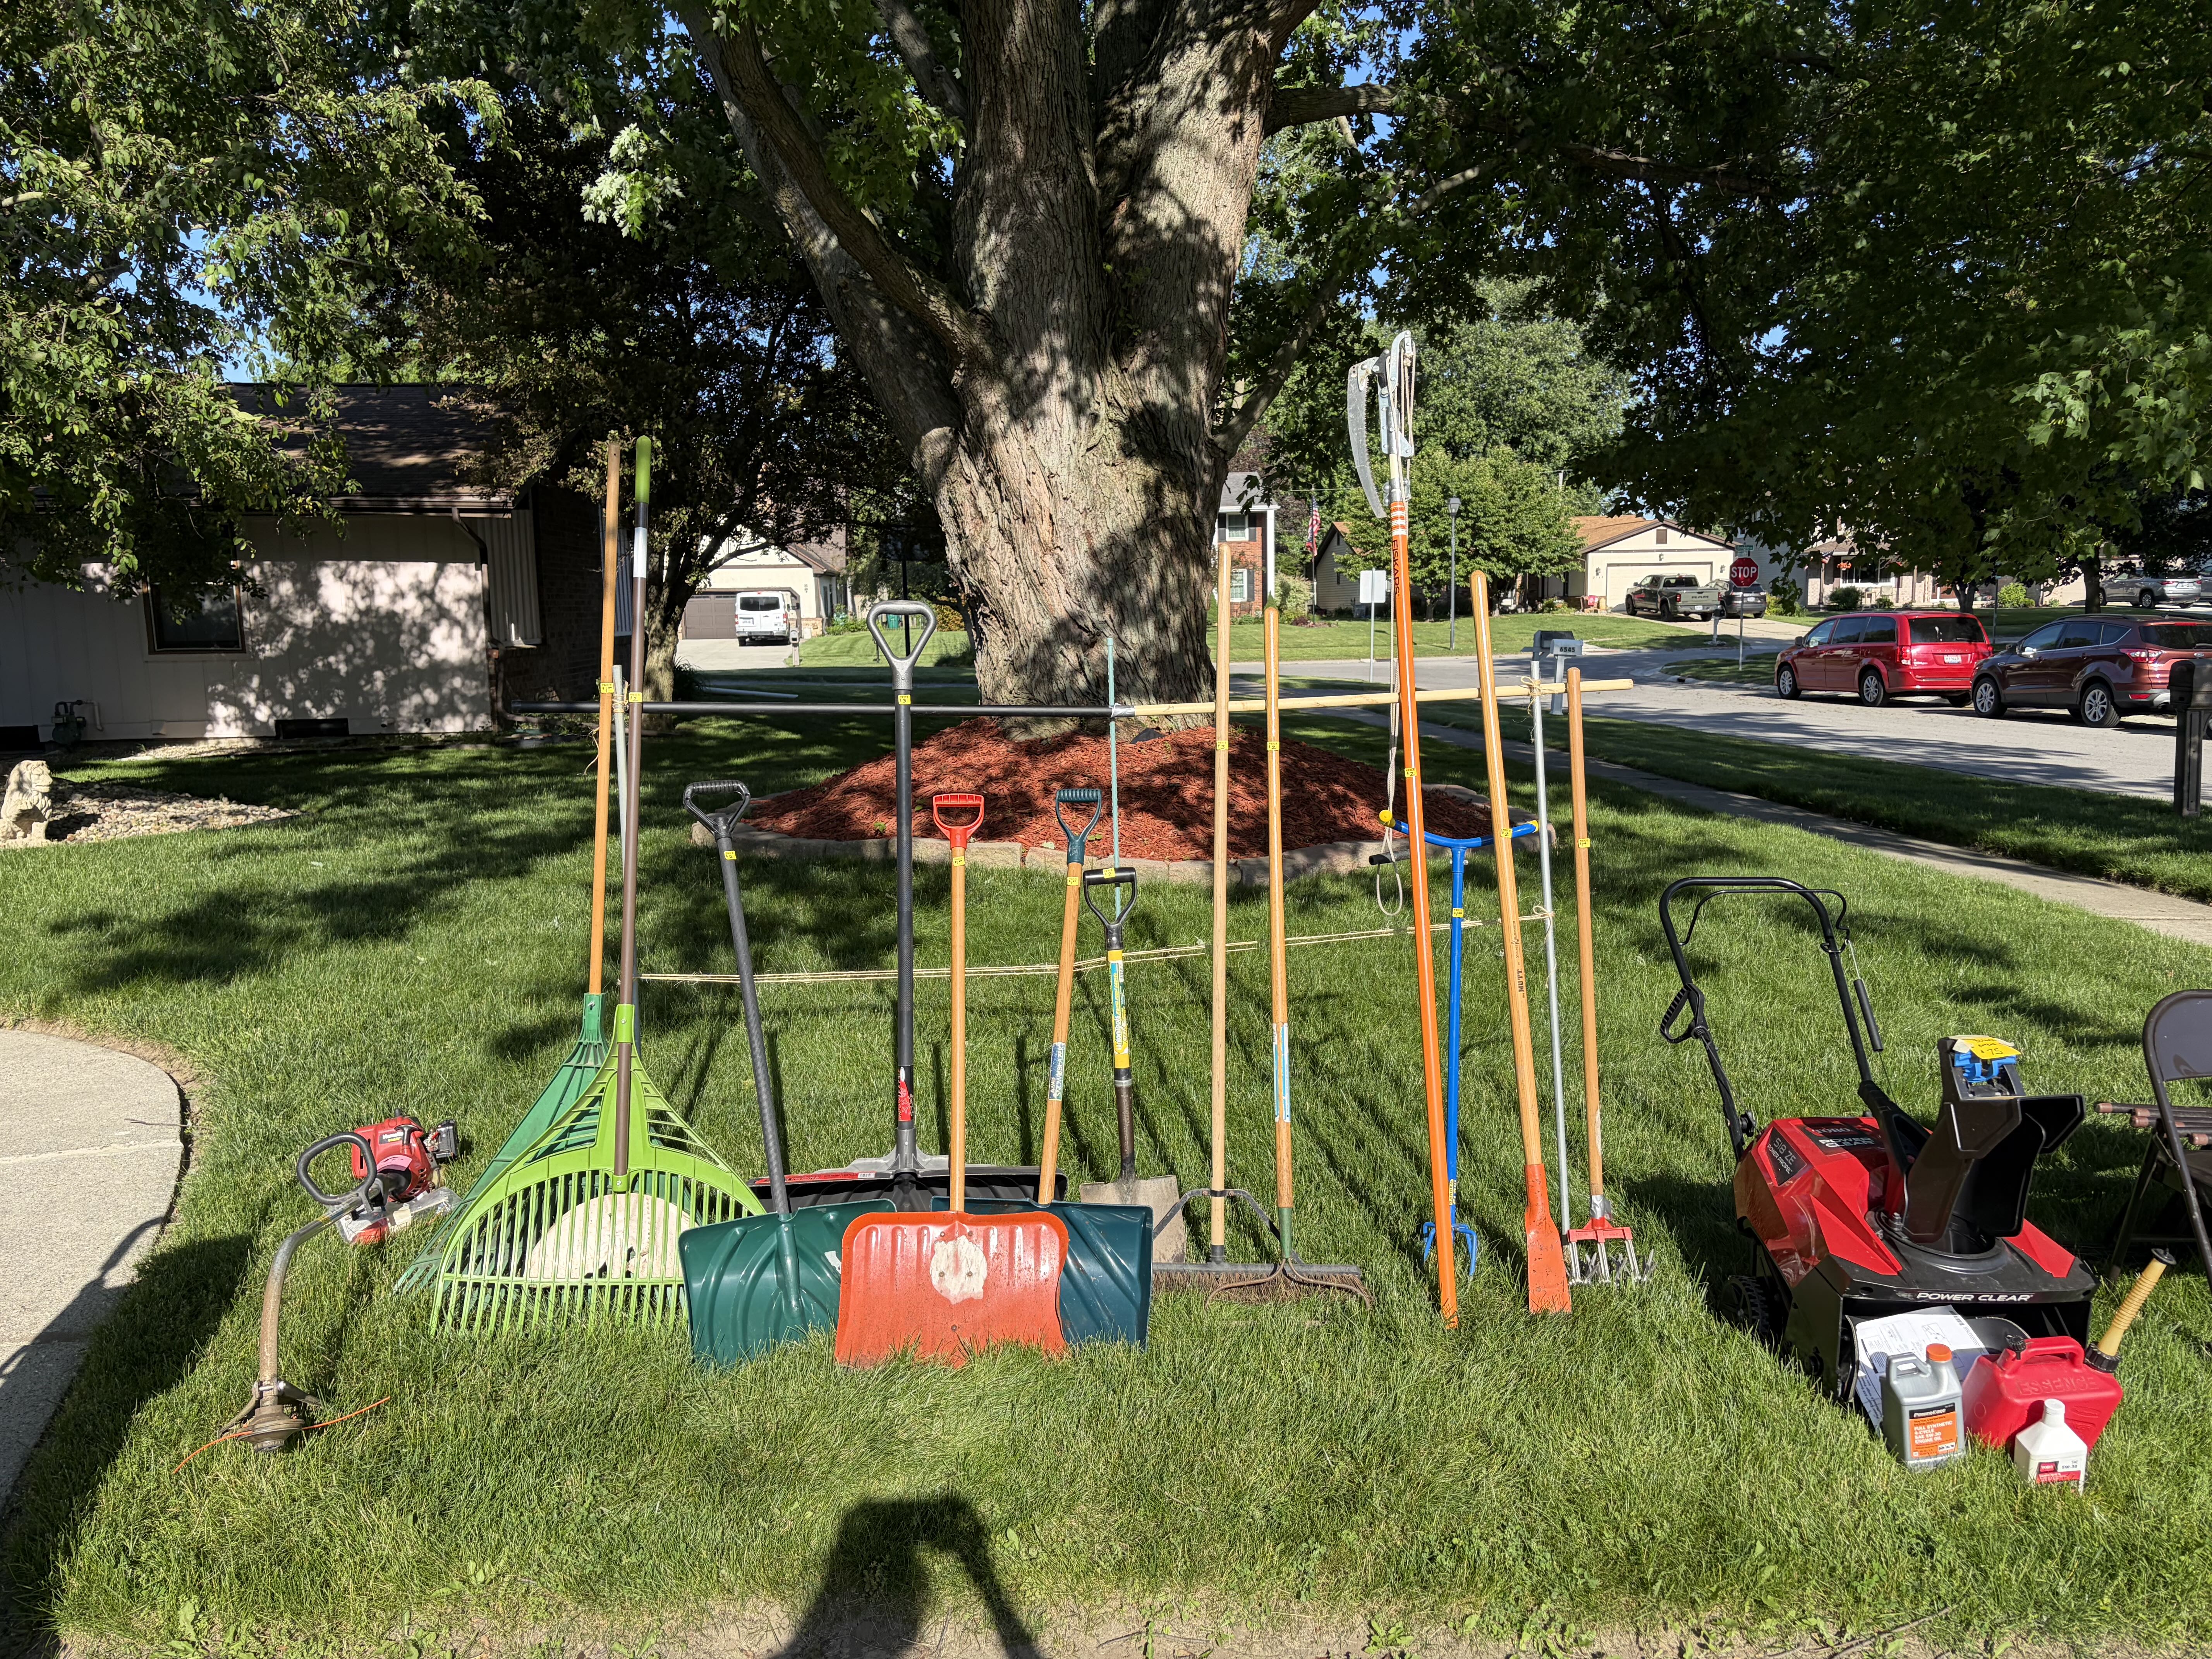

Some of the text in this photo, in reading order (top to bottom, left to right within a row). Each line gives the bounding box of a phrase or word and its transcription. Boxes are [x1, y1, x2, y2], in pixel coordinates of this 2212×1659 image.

[1392, 539, 1401, 596] FISKARS
[1731, 567, 1757, 578] STOP
[1767, 1144, 1791, 1174] POWER PROPEL
[1774, 1138, 1796, 1165] 518 ZE
[1917, 1293, 1974, 1301] POWER
[2020, 1376, 2099, 1396] ESSENCE
[1927, 1420, 1953, 1429] SYNTHETIC
